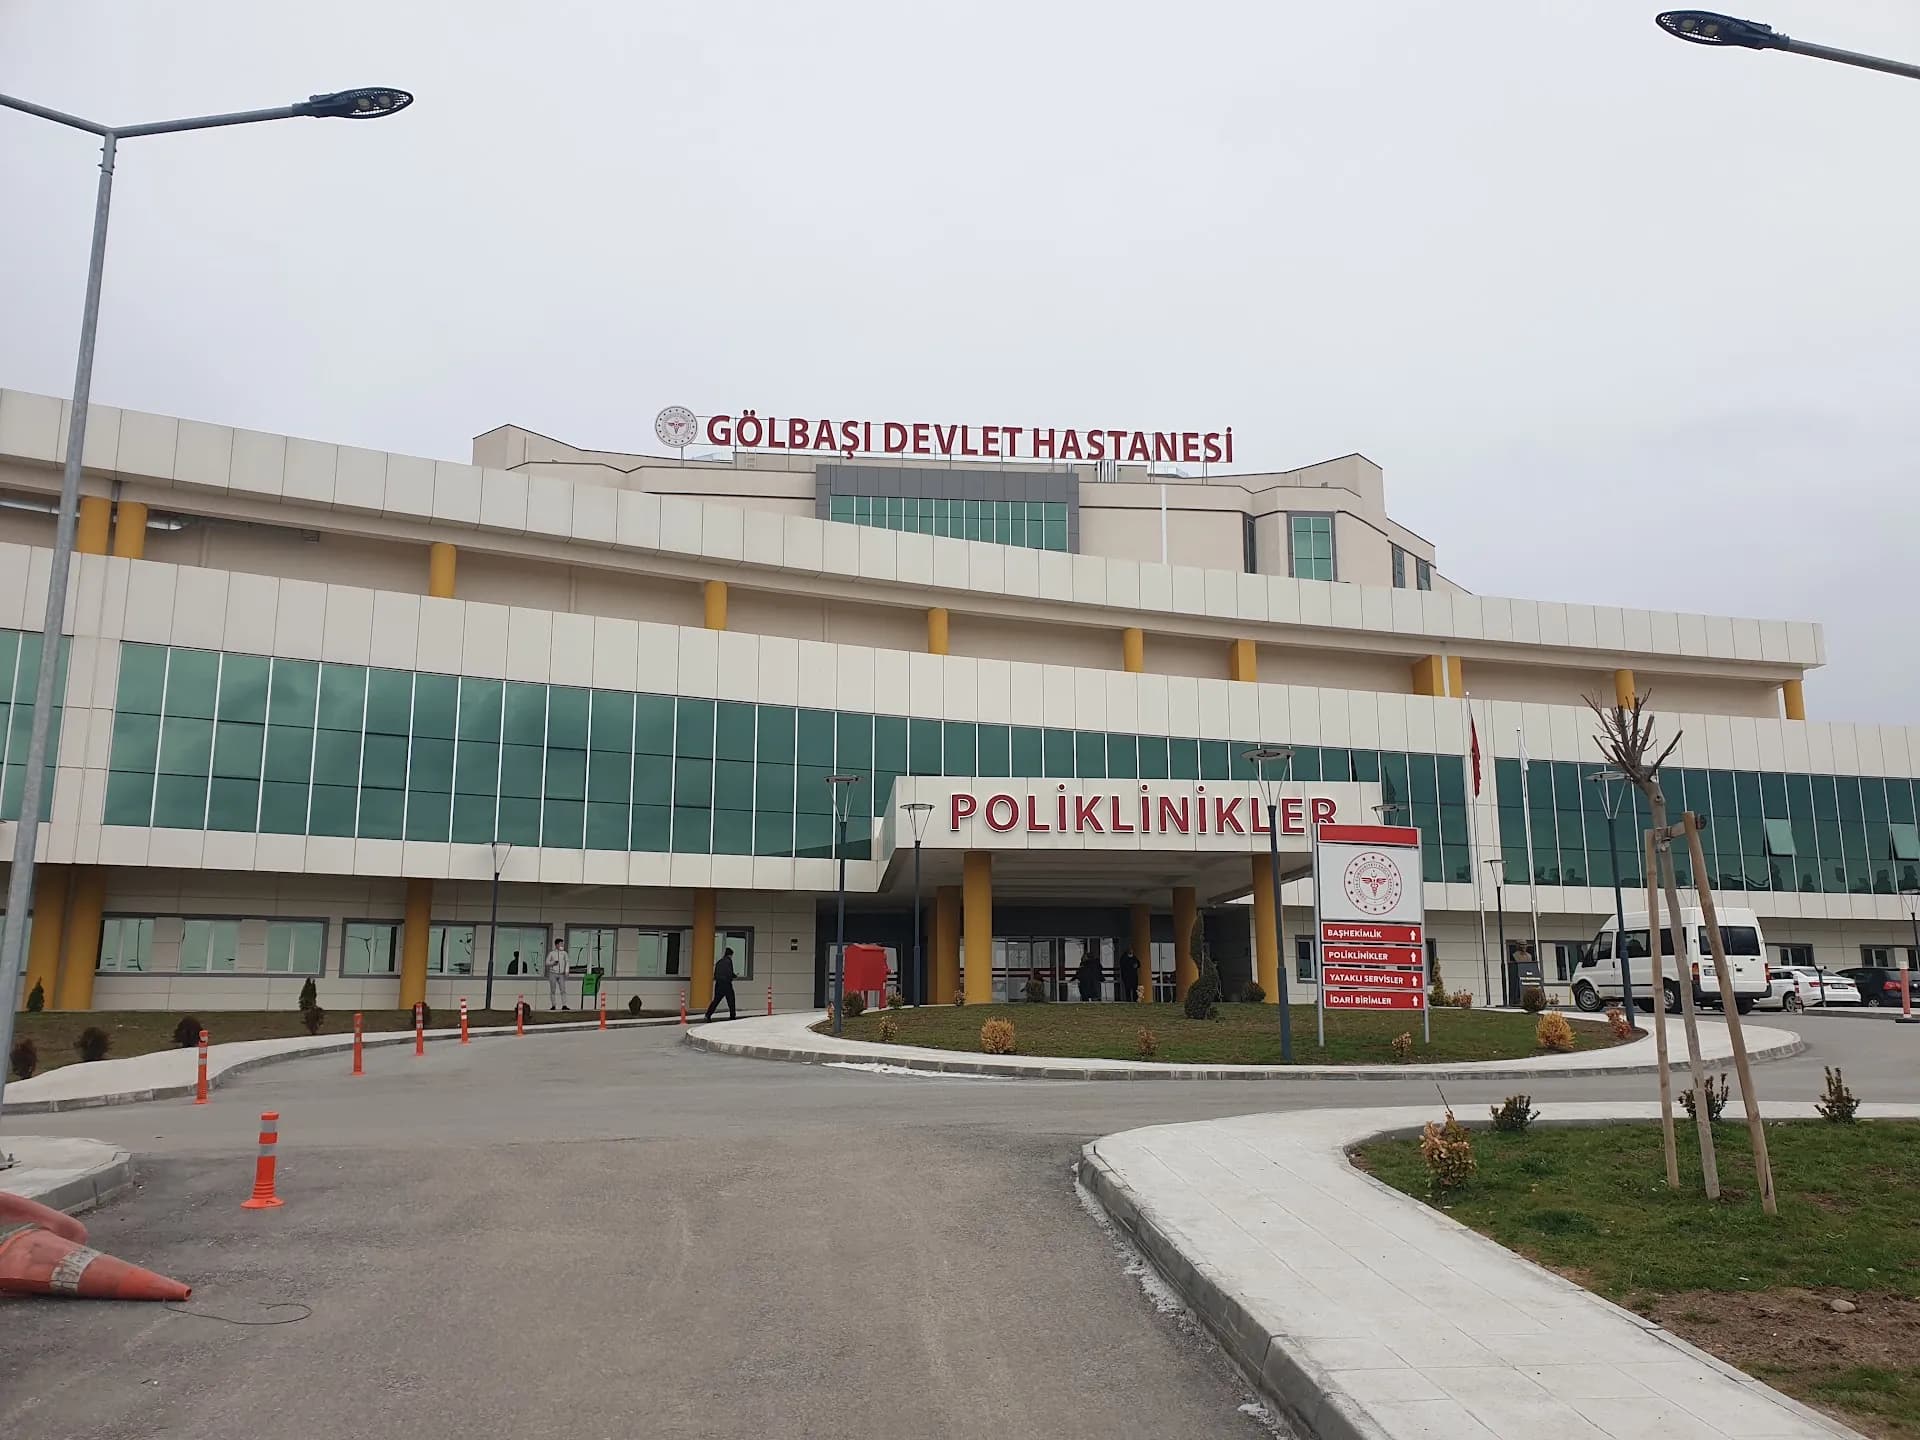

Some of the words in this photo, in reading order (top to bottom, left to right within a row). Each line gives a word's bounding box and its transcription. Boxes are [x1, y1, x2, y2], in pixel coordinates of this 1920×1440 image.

[706, 410, 871, 459] GÖLBAŞI
[883, 423, 1023, 457] DEVLET
[1032, 426, 1233, 464] HASTANESİ
[950, 783, 1337, 835] POLİKLİNİKLER
[1327, 928, 1382, 939] BAŞHEKİMLİK
[1328, 950, 1388, 960] POLİKLİNİKLER
[1329, 973, 1363, 982] YATAKLI
[1363, 974, 1404, 985] SERVİSLER
[1330, 994, 1353, 1004] İDARİ
[1355, 994, 1392, 1006] BİRİMLER
